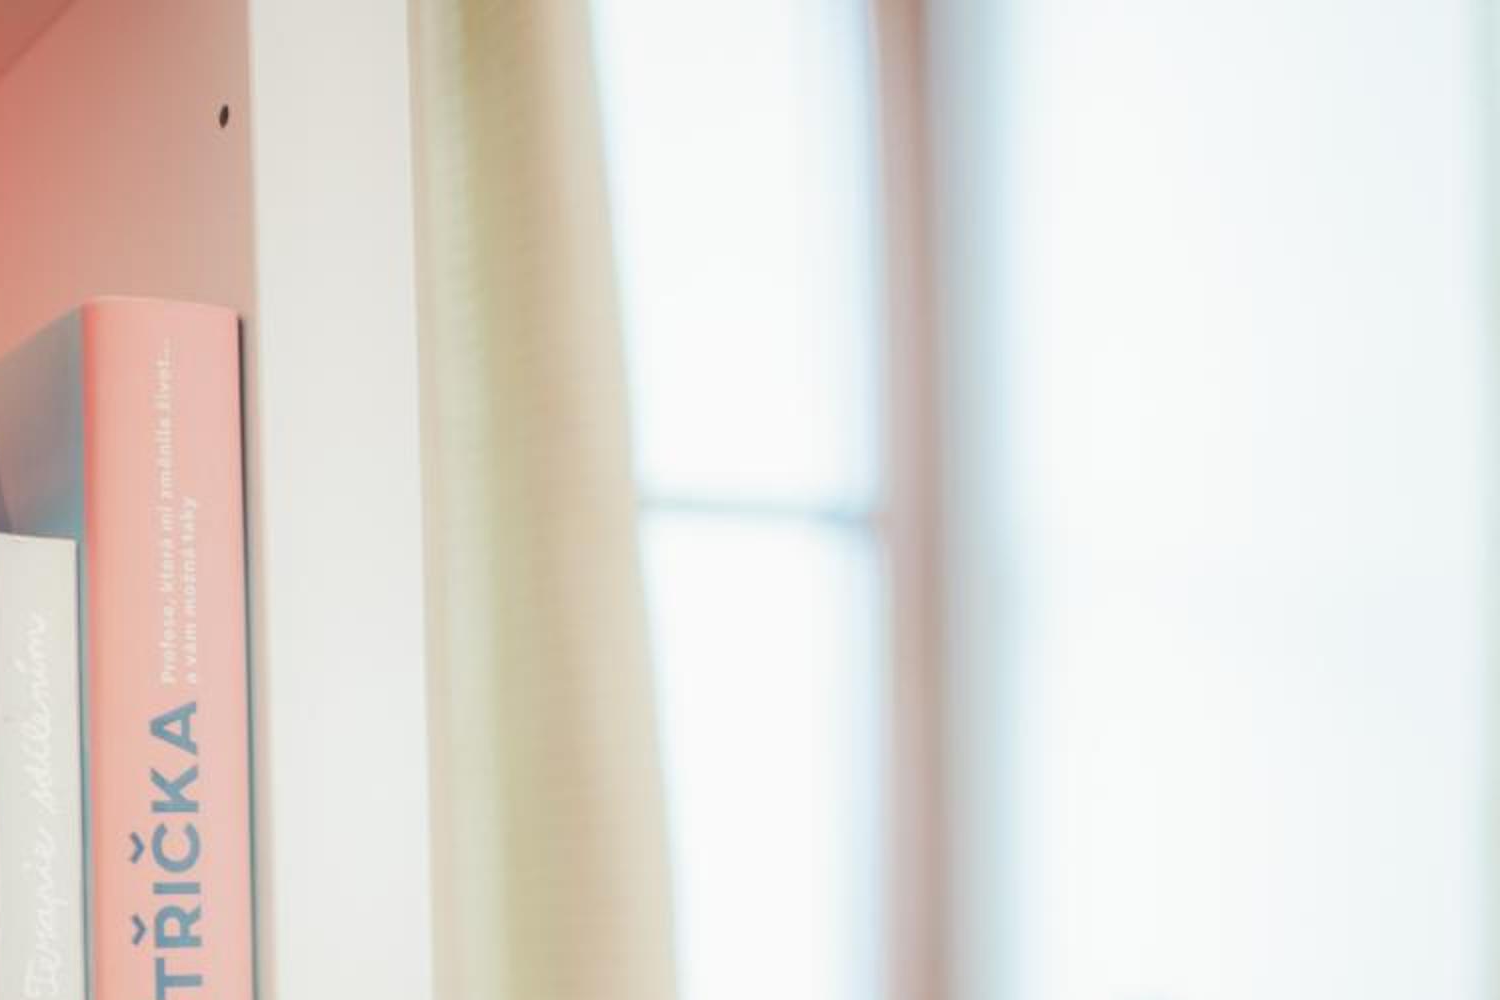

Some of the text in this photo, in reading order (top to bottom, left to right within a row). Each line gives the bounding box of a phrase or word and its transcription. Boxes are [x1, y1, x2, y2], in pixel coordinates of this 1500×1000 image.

[155, 416, 175, 499] změnila
[157, 505, 174, 530] mi
[178, 495, 201, 542] taky
[157, 537, 176, 591] která
[179, 548, 197, 616] možná
[158, 596, 179, 683] Profese,
[180, 622, 198, 666] vám
